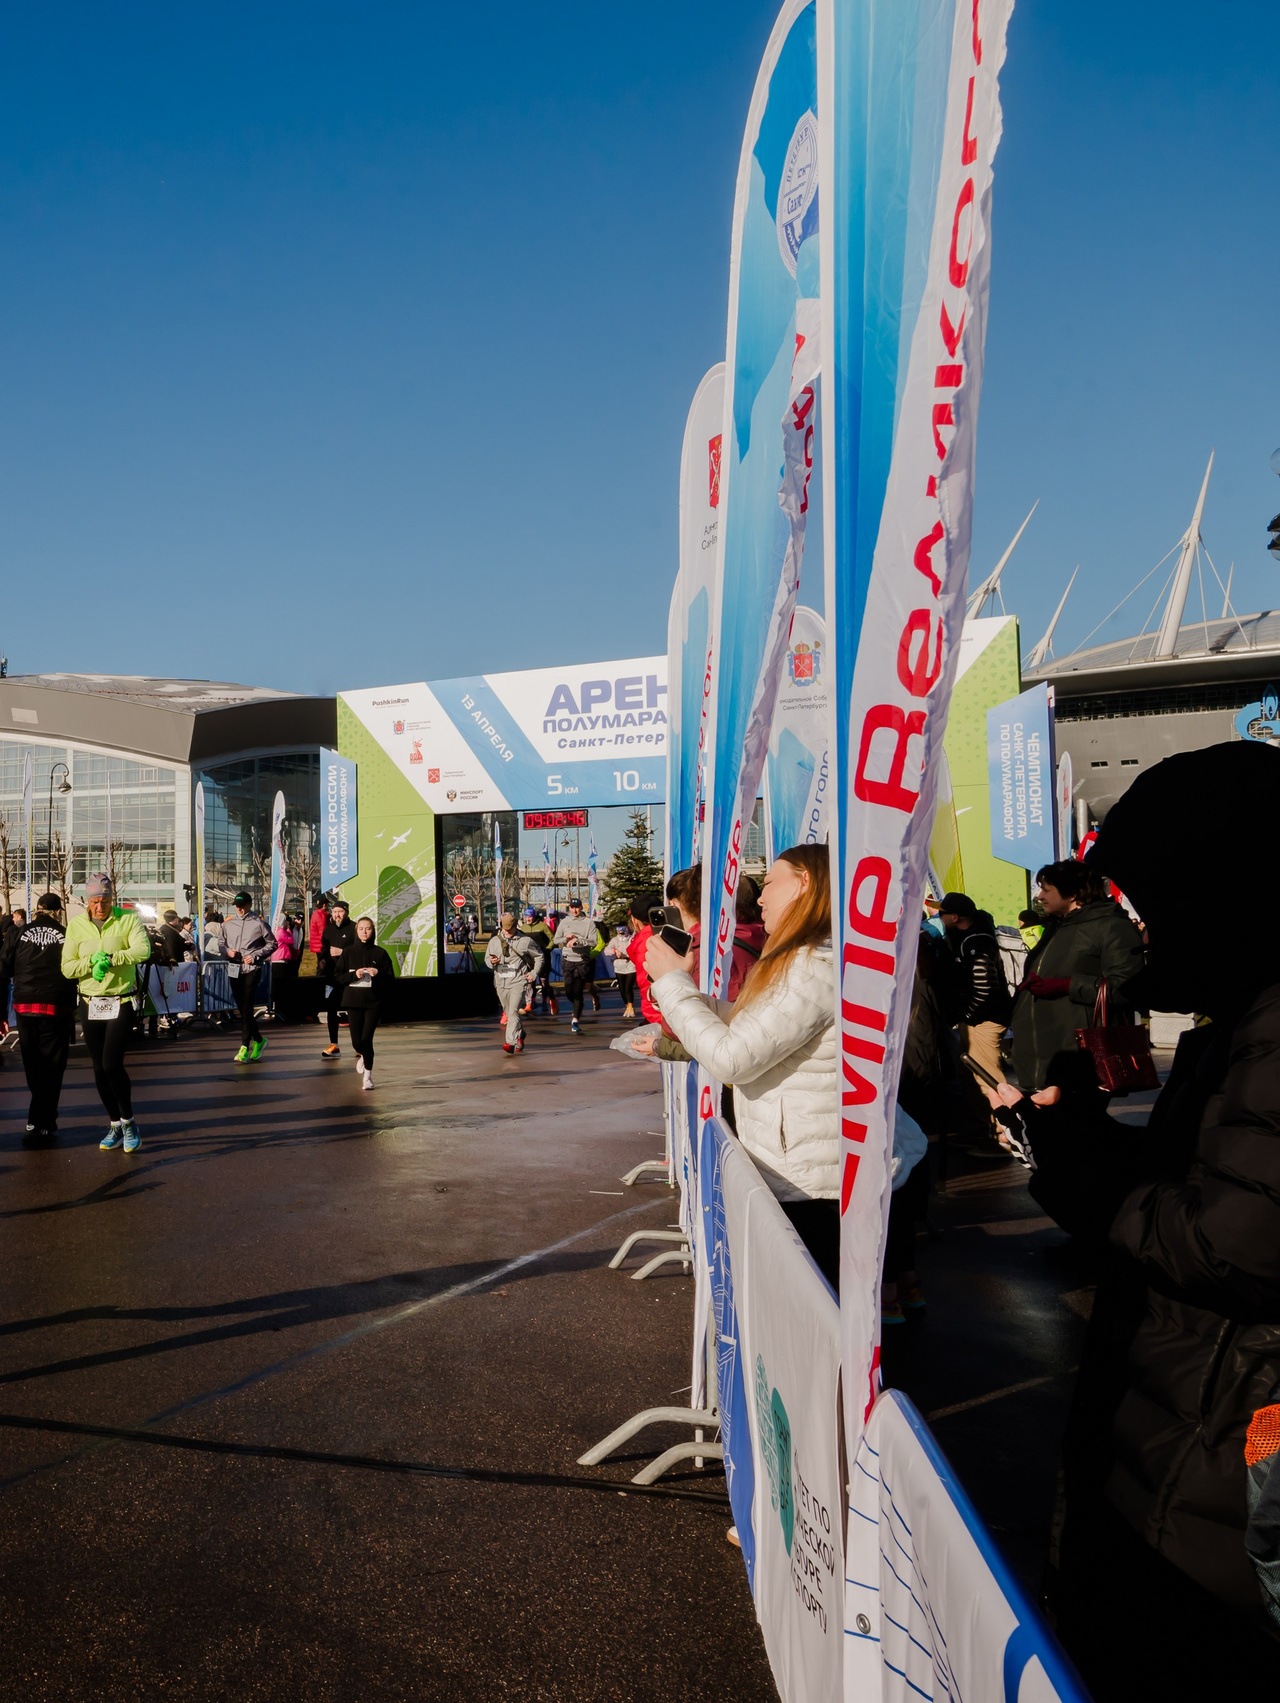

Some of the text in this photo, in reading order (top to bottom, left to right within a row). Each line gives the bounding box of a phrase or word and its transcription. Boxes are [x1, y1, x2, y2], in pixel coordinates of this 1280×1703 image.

[543, 710, 668, 734] ПОЛУМАРА
[544, 674, 668, 717] АРЕН
[461, 693, 514, 763] 13 АПРЕЛЯ
[557, 733, 665, 749] Санкт-Петер
[547, 774, 563, 795] 5
[613, 770, 640, 792] 10
[1000, 724, 1014, 840] ПО ПОЛУМАРАФОНУ
[1013, 722, 1028, 838] САНКТ-ПЕТЕРБУРГА
[1027, 732, 1043, 826] ЧЕМПИОНАТ
[328, 764, 338, 875] КУБОК РОССИИ
[340, 767, 349, 872] ПО ПОЛУМАРАФОНУ
[812, 1495, 831, 1535] ПО
